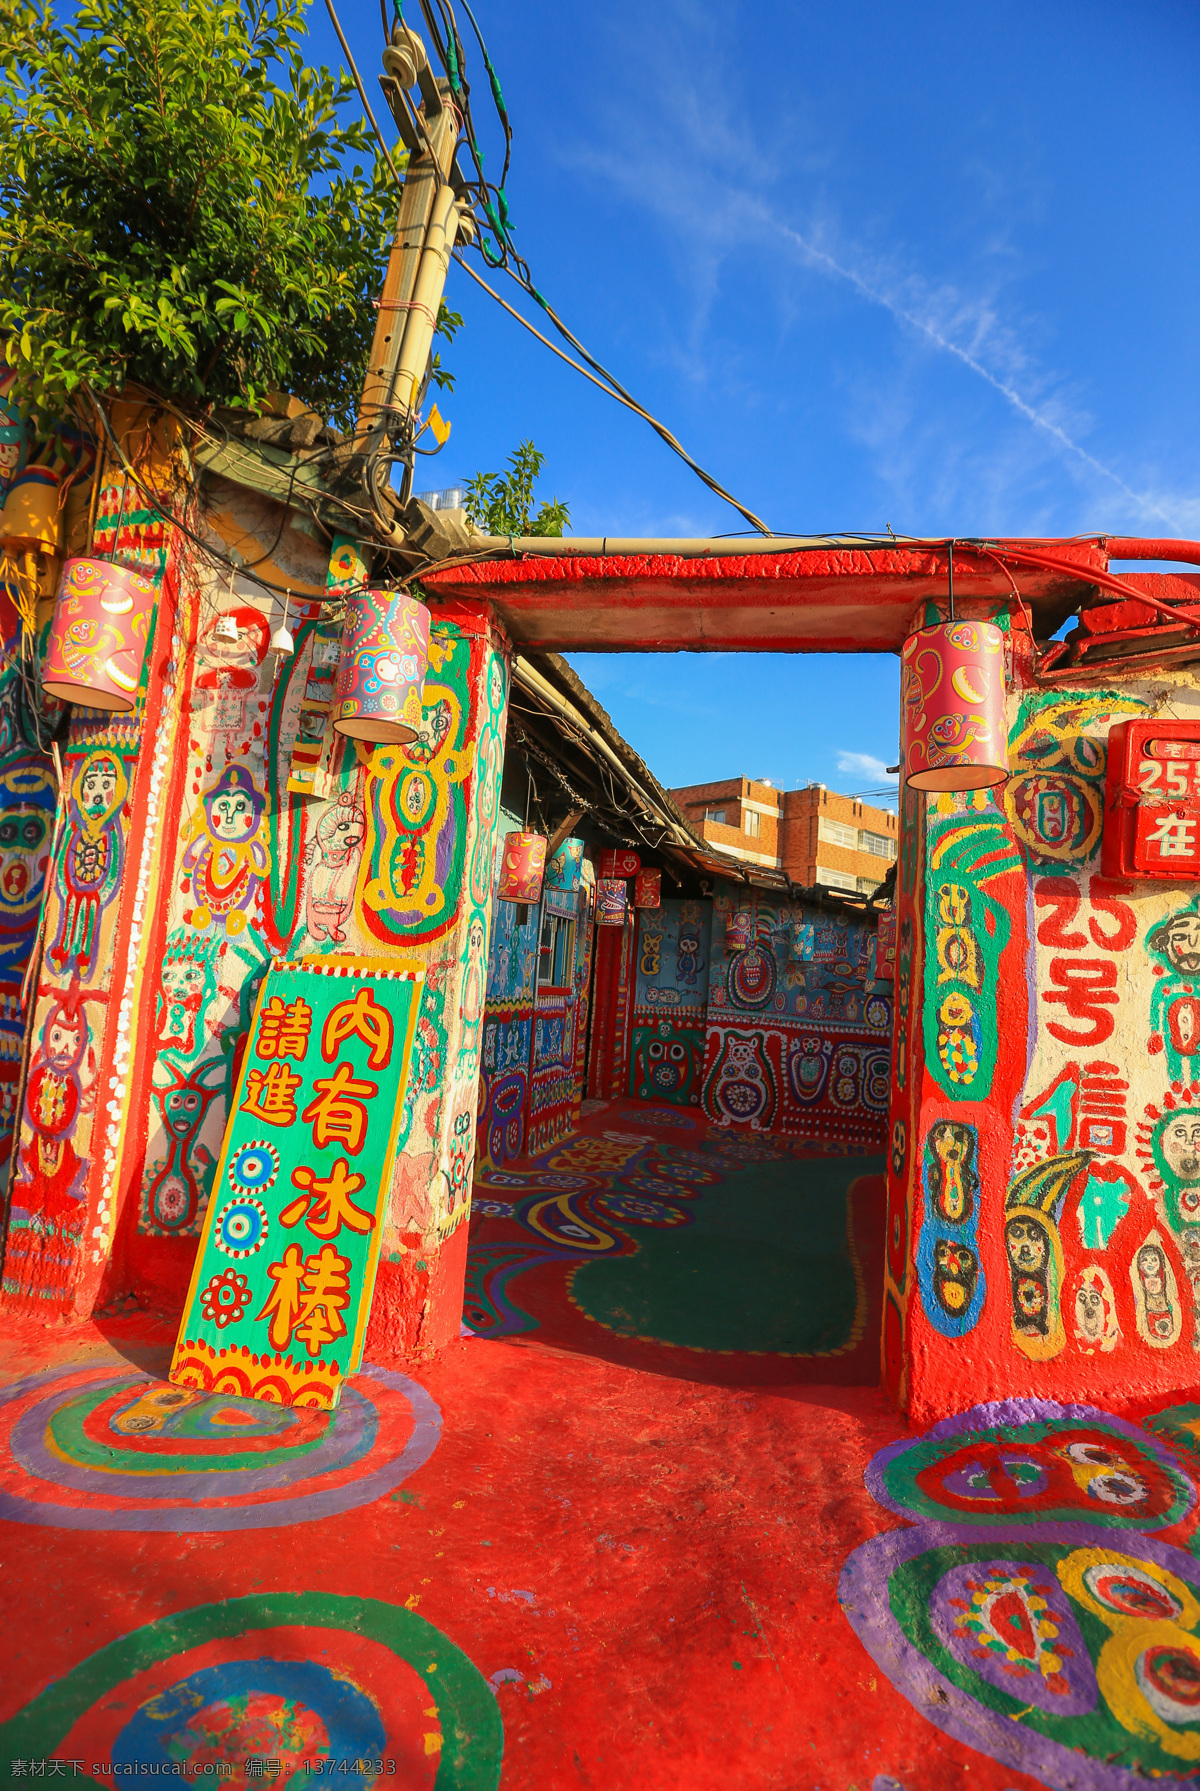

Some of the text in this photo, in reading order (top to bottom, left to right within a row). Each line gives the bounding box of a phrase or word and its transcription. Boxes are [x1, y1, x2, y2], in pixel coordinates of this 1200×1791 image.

[1137, 760, 1200, 796] 25
[1146, 812, 1197, 857] 在
[240, 996, 312, 1127] 請進
